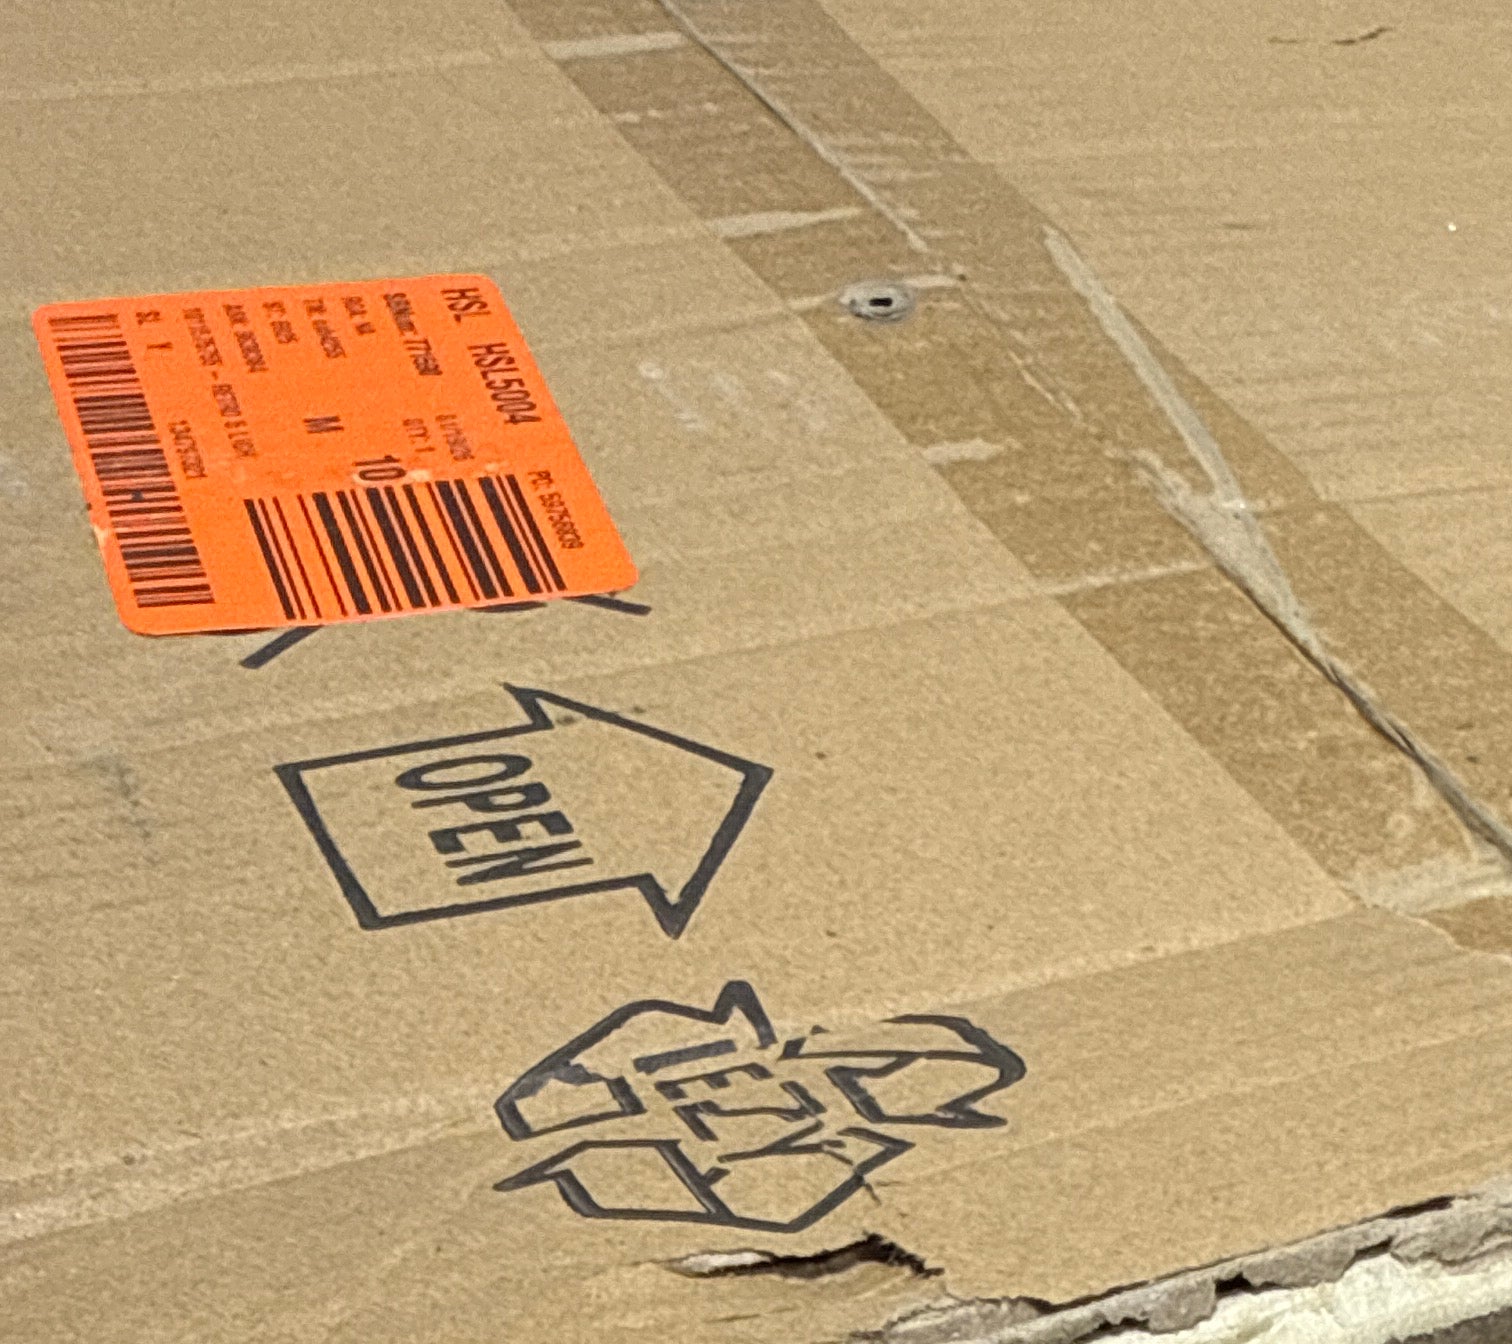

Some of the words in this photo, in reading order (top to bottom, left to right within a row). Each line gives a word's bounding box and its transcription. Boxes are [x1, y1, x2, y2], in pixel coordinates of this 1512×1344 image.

[442, 288, 490, 322] HSL
[468, 343, 540, 424] HSL5004
[304, 415, 342, 434] M
[352, 455, 405, 481] 10
[395, 753, 593, 886] OPEN
